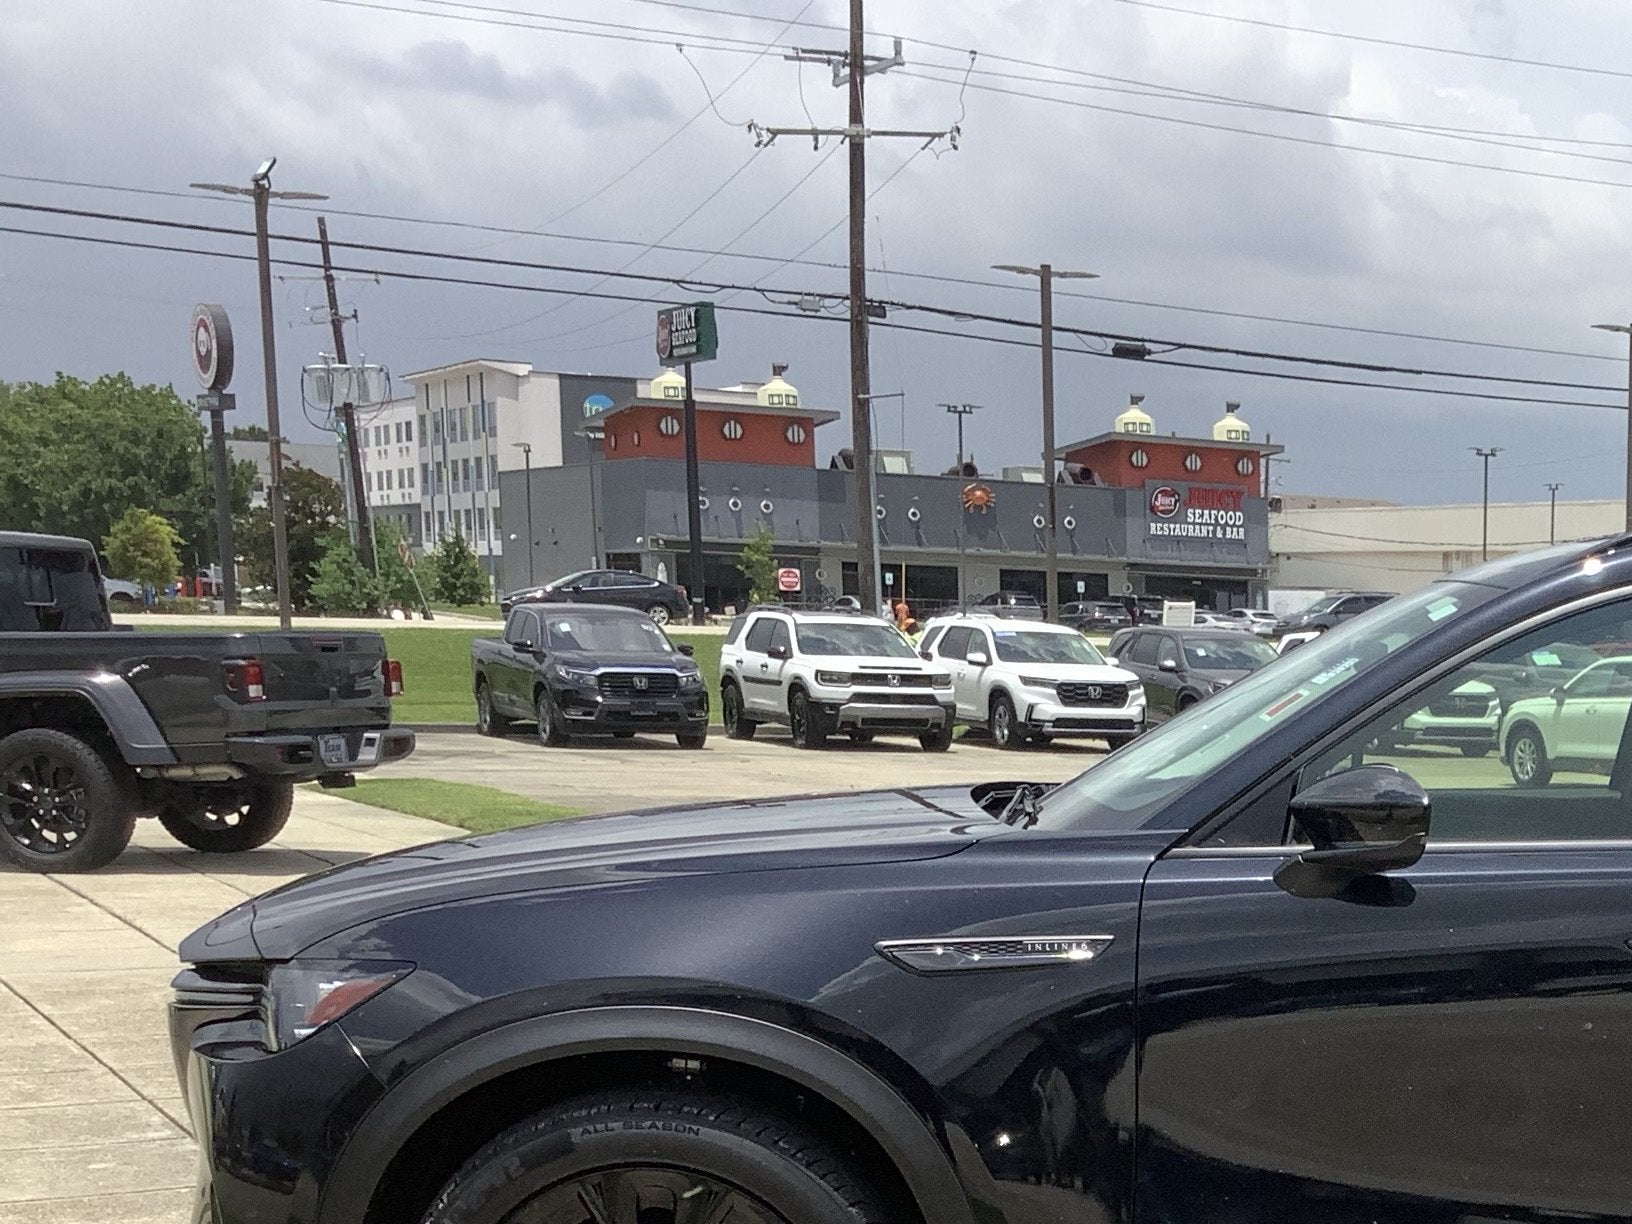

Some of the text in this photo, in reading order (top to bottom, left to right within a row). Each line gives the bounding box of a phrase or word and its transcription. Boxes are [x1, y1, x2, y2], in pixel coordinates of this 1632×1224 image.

[671, 306, 696, 331] JUICY
[1187, 509, 1243, 525] SEAFOOD
[1150, 522, 1245, 540] RESTAURANT & BAR
[581, 1120, 701, 1137] ALL SEASON
